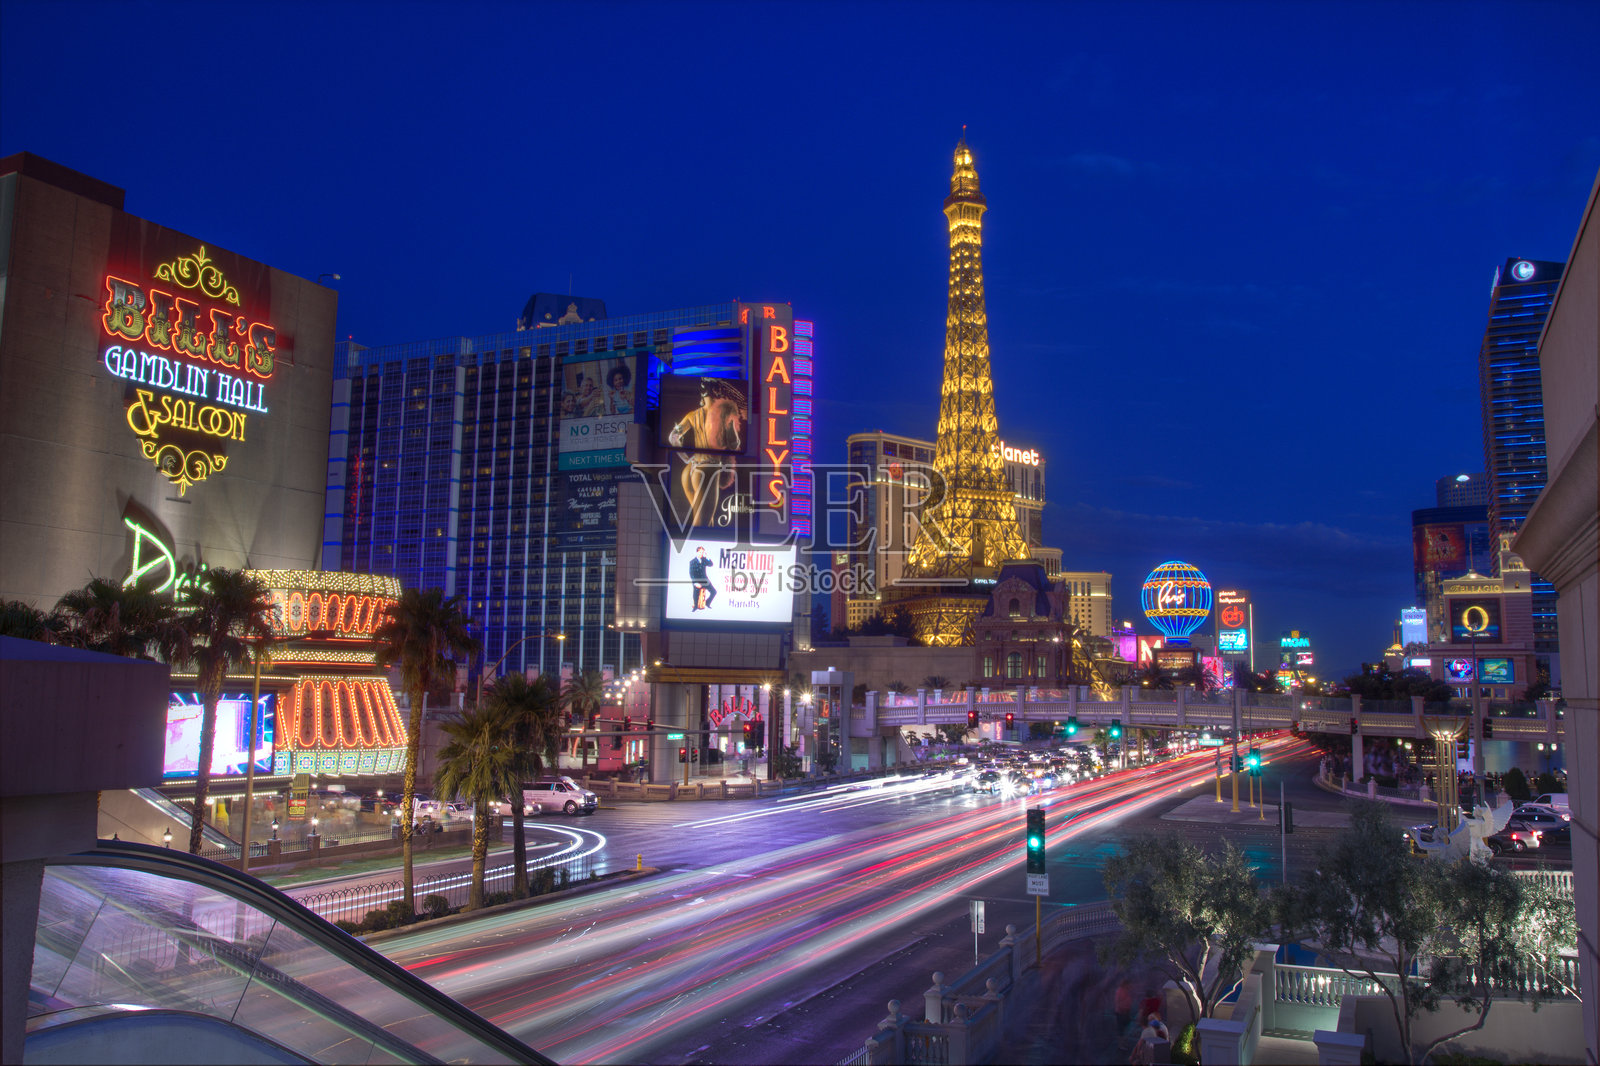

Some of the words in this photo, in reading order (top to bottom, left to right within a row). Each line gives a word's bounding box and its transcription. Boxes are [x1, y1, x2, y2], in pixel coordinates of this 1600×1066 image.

[102, 275, 277, 379] BILL'S
[217, 371, 269, 413] HALL
[158, 396, 248, 442] SALOON
[570, 424, 590, 437] NO
[594, 421, 634, 435] RESO
[568, 455, 591, 465] NEXT
[593, 454, 613, 464] TIME
[568, 474, 592, 483] TOTAL
[1157, 581, 1185, 612] Paris
